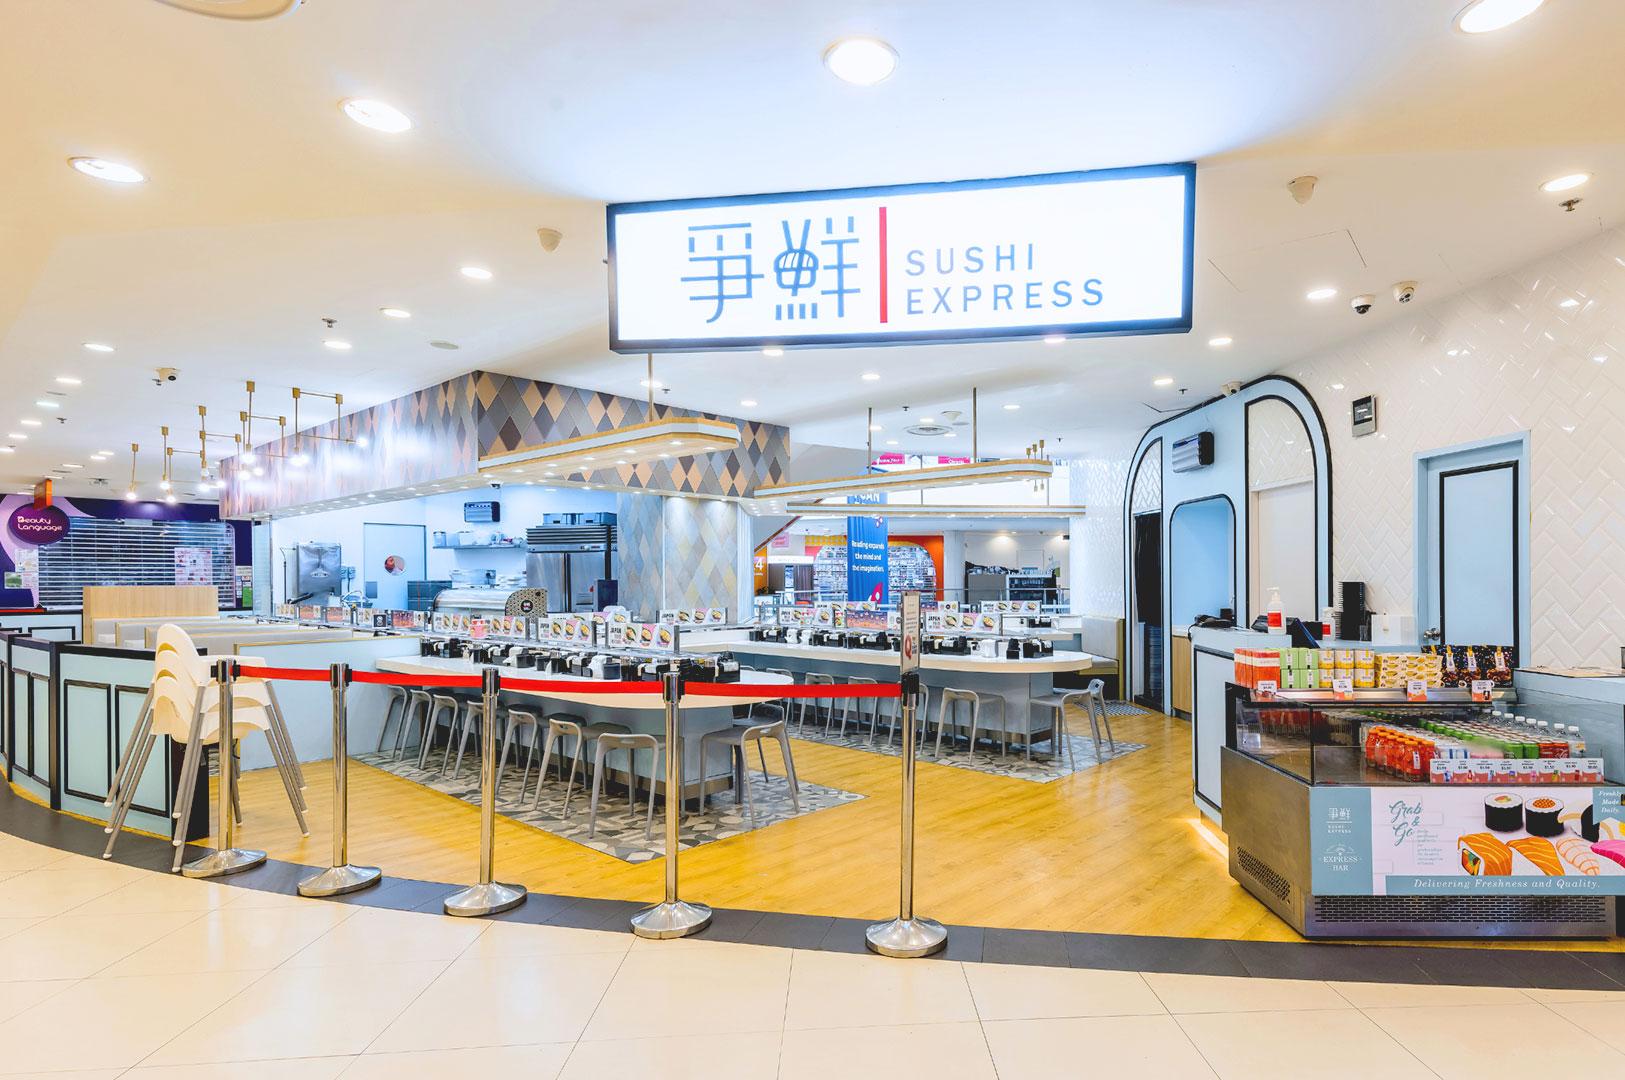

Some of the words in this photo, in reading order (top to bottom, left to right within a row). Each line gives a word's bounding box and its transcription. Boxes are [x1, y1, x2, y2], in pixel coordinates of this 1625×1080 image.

[905, 243, 1035, 276] SUSHI
[907, 278, 1104, 316] EXPRESS
[17, 515, 51, 525] Beauty
[17, 523, 63, 532] Language
[868, 542, 885, 550] expands
[1389, 800, 1422, 823] Grab
[1411, 816, 1420, 826] &
[1393, 822, 1414, 846] Go
[1414, 879, 1470, 889] Delivering
[1475, 879, 1528, 888] Freshness
[1532, 879, 1552, 888] and
[1556, 878, 1600, 889] Quality.
